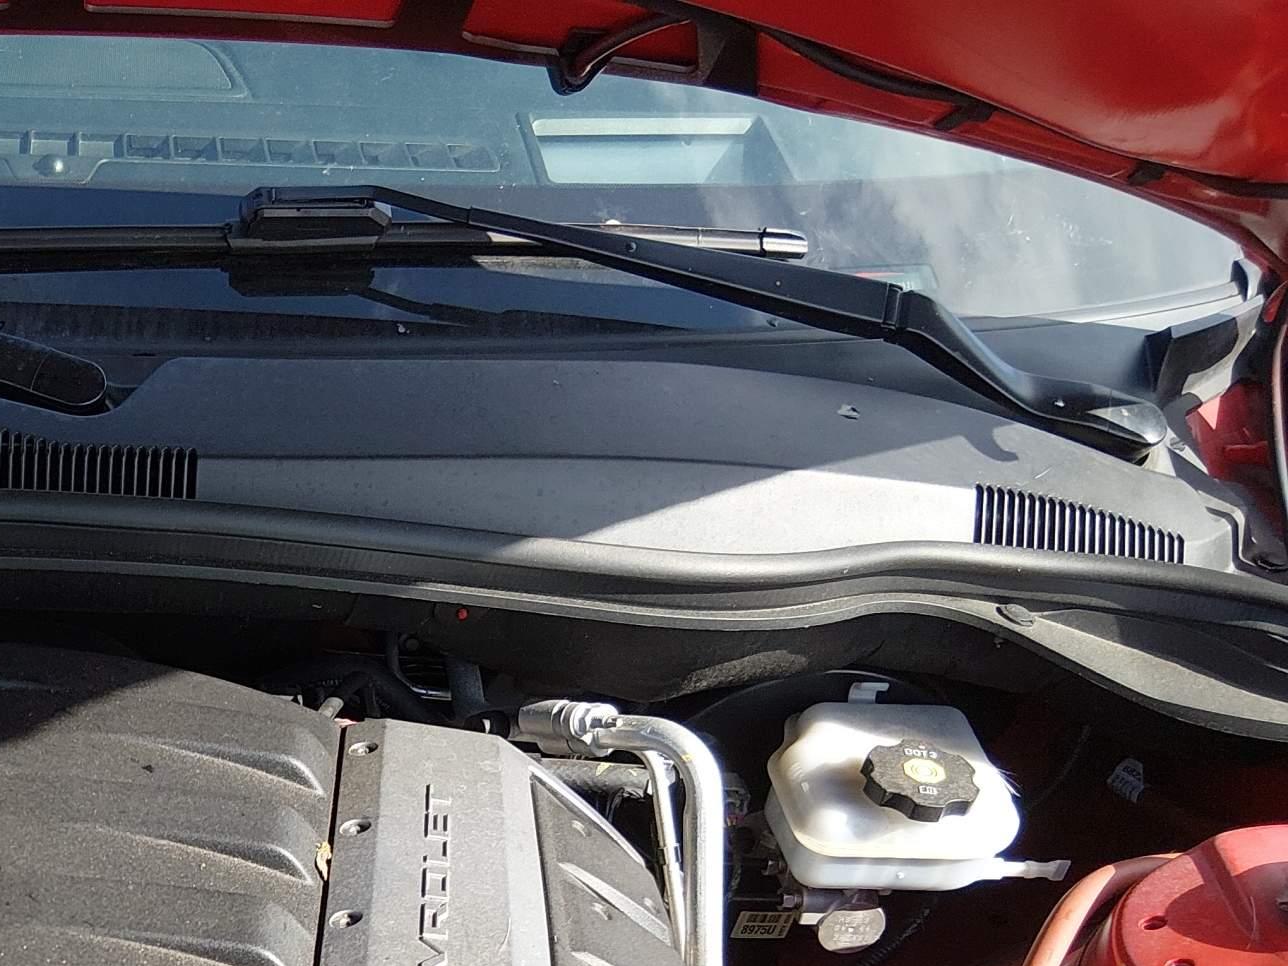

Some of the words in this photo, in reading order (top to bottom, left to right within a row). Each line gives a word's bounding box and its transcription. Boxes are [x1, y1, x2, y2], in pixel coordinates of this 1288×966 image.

[903, 747, 928, 759] DOT
[928, 750, 938, 759] 3
[740, 924, 776, 935] 8975U
